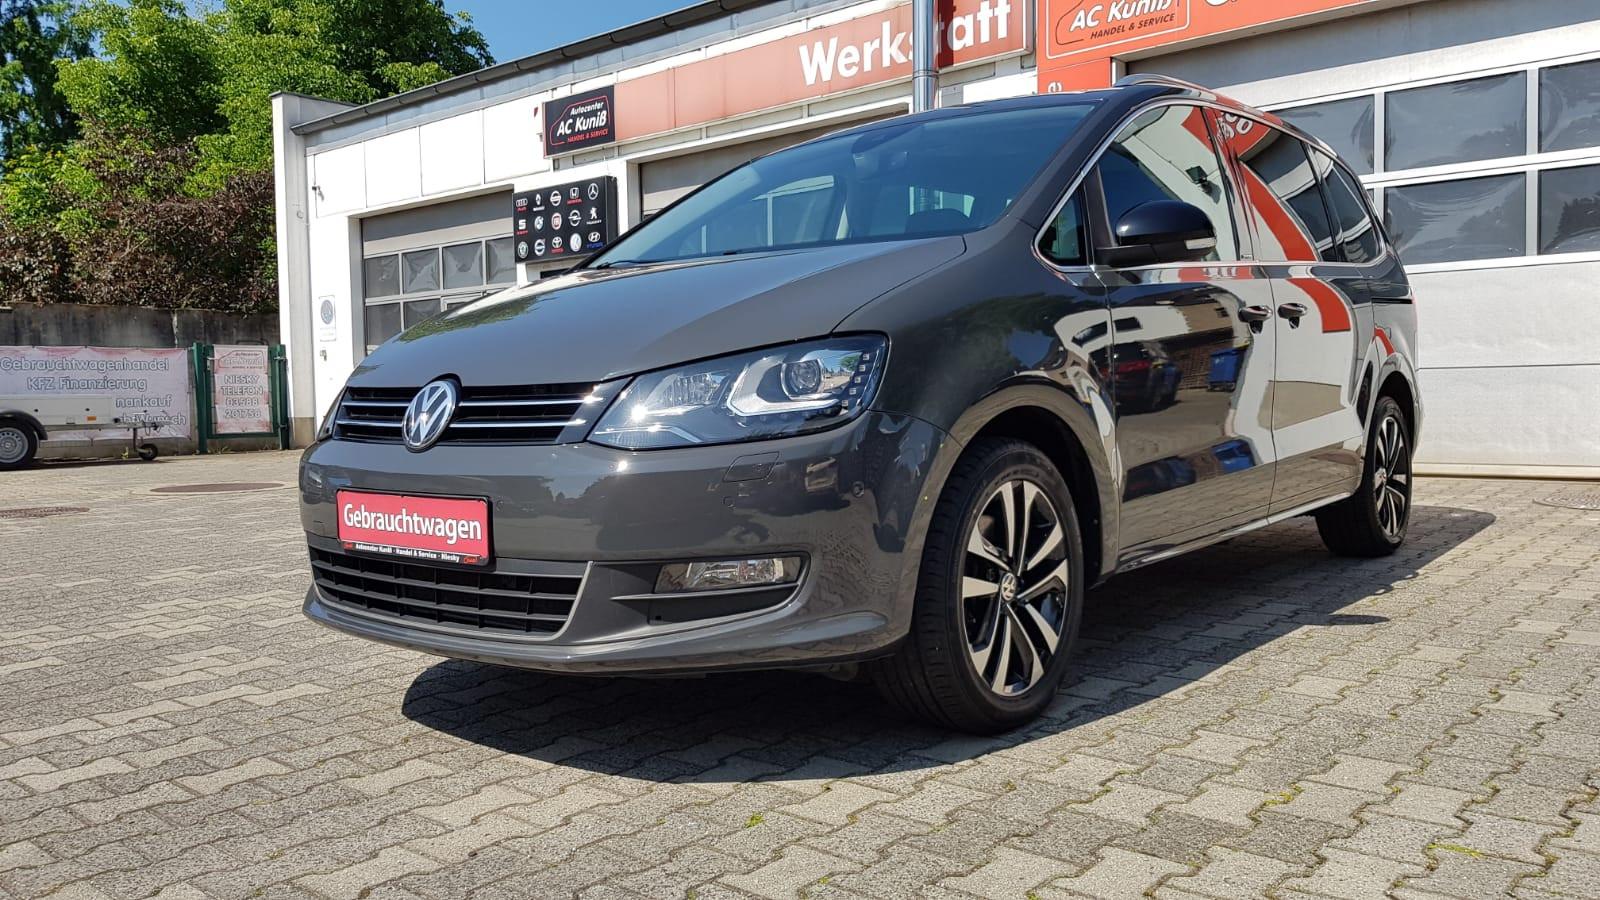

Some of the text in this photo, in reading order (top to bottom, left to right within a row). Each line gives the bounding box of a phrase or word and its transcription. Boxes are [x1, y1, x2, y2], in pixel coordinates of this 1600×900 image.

[1069, 5, 1103, 32] AC
[1090, 13, 1175, 40] HANDEL & SERVICE
[798, 0, 1011, 86] Werktatt
[570, 101, 604, 116] Autocenter
[556, 118, 573, 137] AC
[0, 356, 169, 373] Gebrauchtwagenhandel
[27, 375, 148, 393] KFZ Finanzierung
[223, 375, 260, 385] NIESKY
[221, 385, 264, 396] TELEFON
[344, 504, 481, 544] Gebrauchtwagen
